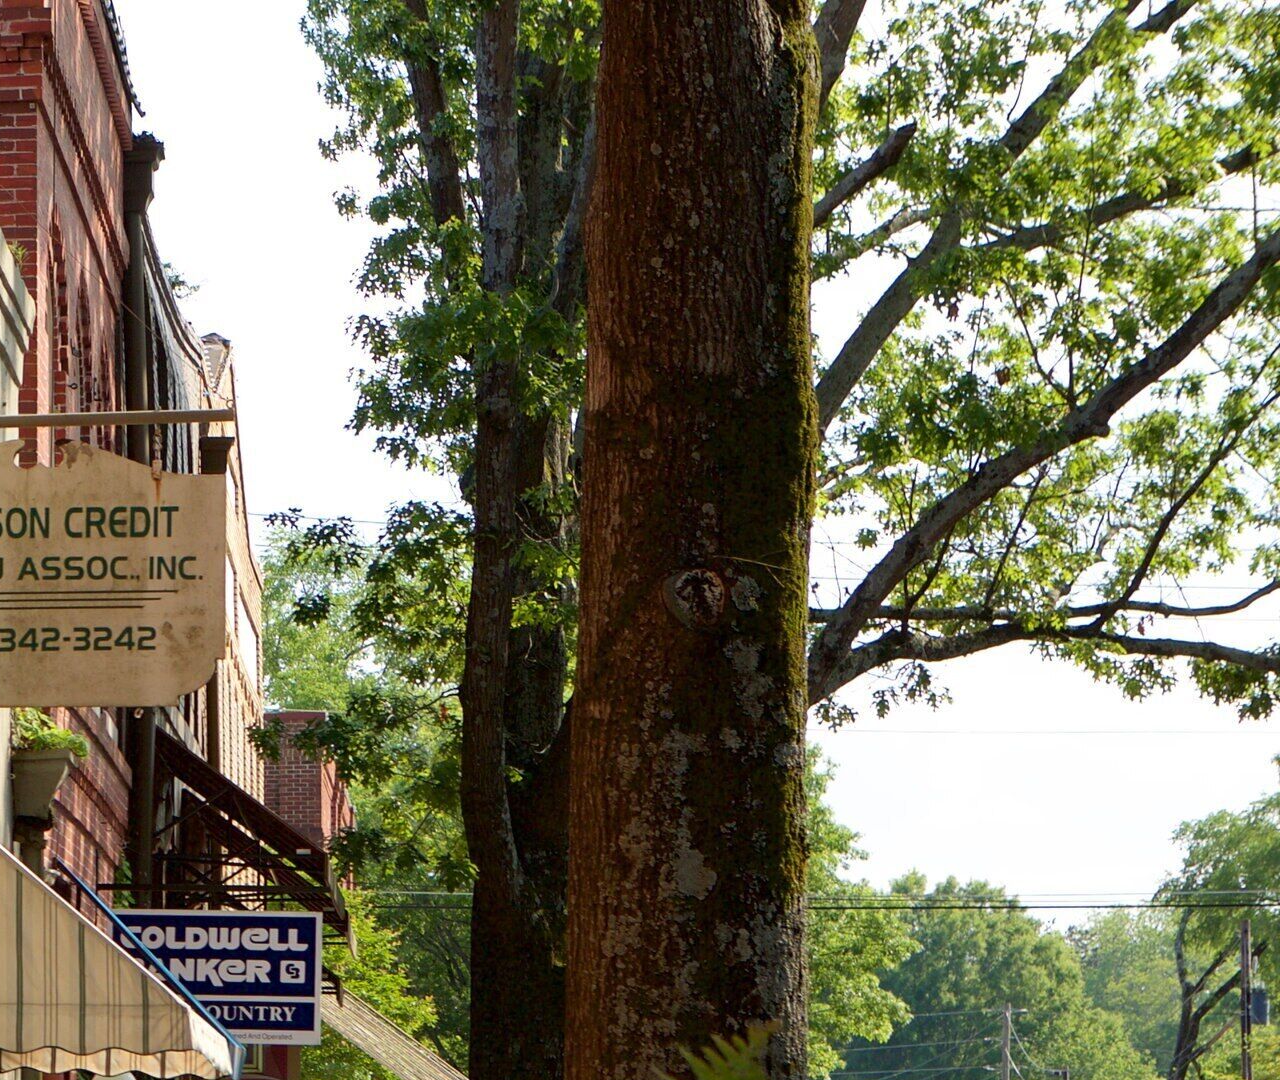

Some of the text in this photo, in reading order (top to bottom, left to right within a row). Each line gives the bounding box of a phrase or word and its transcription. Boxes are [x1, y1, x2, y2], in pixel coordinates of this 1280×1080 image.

[64, 506, 179, 538] CREDIT
[149, 556, 203, 580] INC.
[136, 957, 271, 987] NKER
[207, 1005, 297, 1022] OUNTRY
